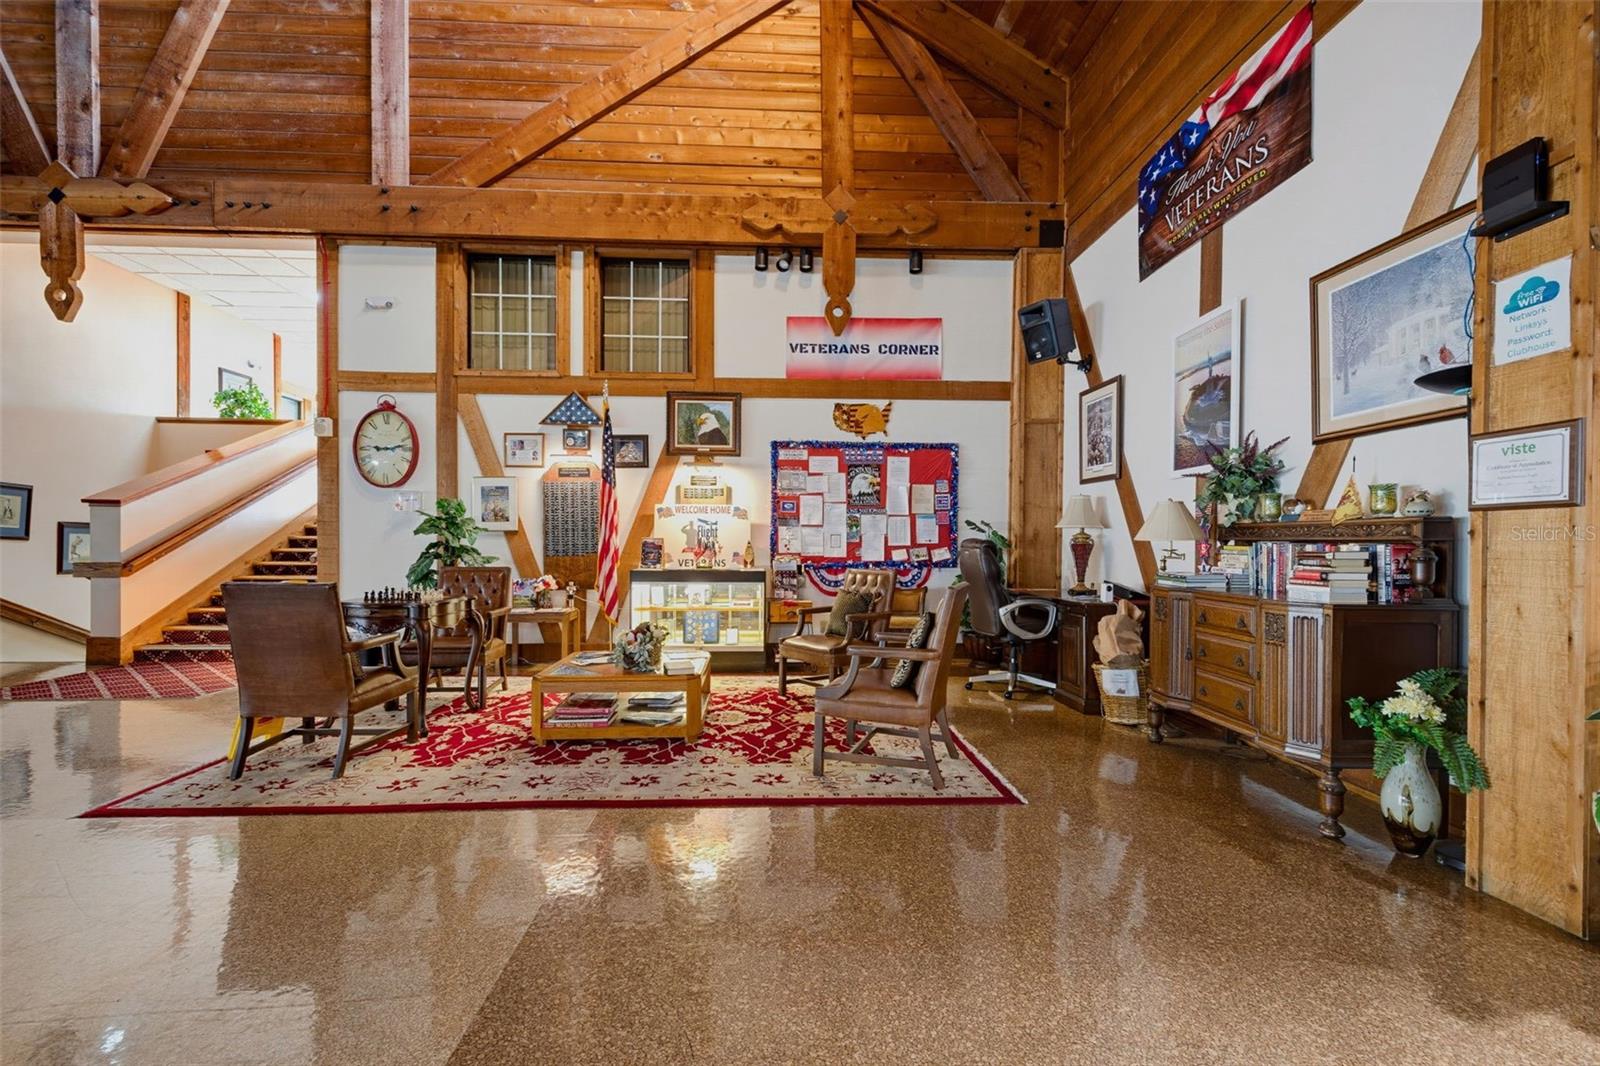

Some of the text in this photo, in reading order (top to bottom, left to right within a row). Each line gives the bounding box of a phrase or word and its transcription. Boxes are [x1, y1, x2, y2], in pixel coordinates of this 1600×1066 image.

[1165, 120, 1257, 206] Thank You
[1165, 136, 1269, 231] VETERANS
[1168, 218, 1197, 246] HONORING
[1213, 193, 1231, 210] WHO
[1232, 169, 1267, 195] SERVED
[1514, 319, 1548, 333] Linksys
[789, 343, 939, 355] VETERANS CORNER
[1507, 340, 1557, 358] Clubhouse
[1501, 442, 1537, 457] viste
[675, 505, 731, 514] WELCOME HOME
[678, 559, 726, 567] VETNS
